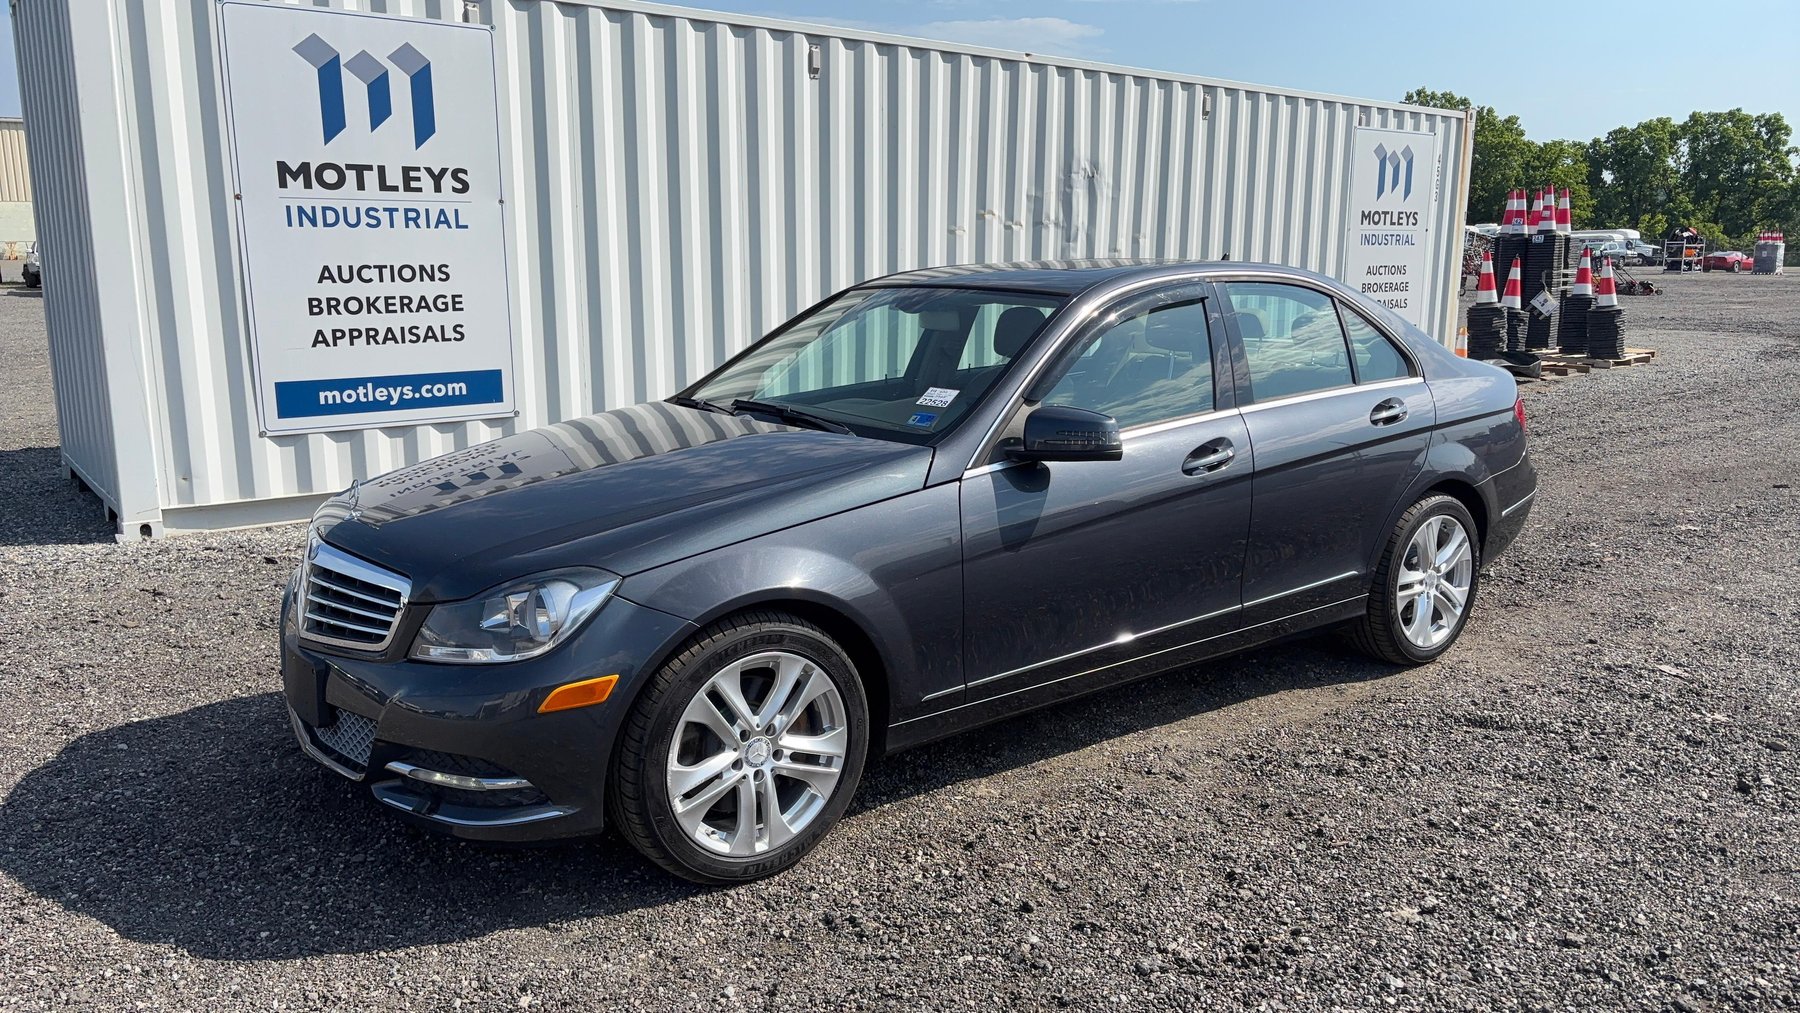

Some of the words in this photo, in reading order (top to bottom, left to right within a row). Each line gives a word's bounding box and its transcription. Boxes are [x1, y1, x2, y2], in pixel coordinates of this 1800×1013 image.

[277, 160, 470, 194] MOTLEYS
[285, 205, 469, 230] INDUSTRIAL
[1360, 210, 1418, 226] MOTLEYS
[1360, 234, 1415, 246] INDUSTRIAL
[317, 264, 451, 284] AUCTIONS
[1366, 265, 1407, 276] AUCTIONS
[1361, 281, 1409, 293] BROKERAGE
[308, 294, 464, 316] BROKERAGE
[311, 324, 465, 348] APPRAISALS
[319, 381, 467, 406] motleys.com
